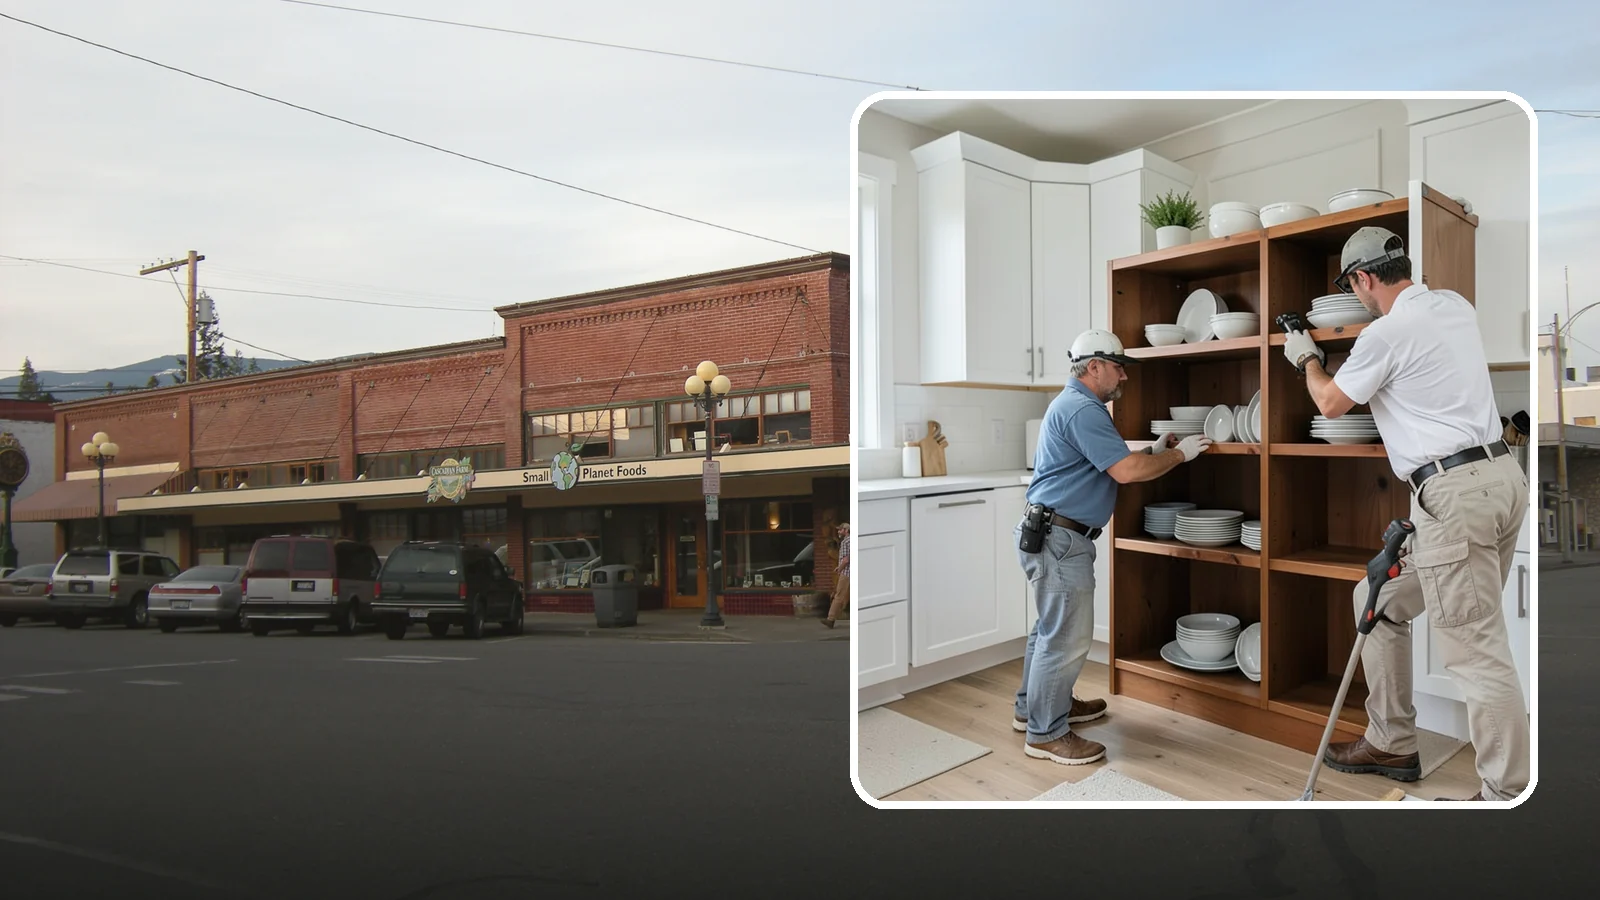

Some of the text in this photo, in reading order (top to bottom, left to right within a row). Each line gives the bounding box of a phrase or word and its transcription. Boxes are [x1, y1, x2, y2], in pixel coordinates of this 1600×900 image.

[523, 464, 647, 483] Small Planet Foods
